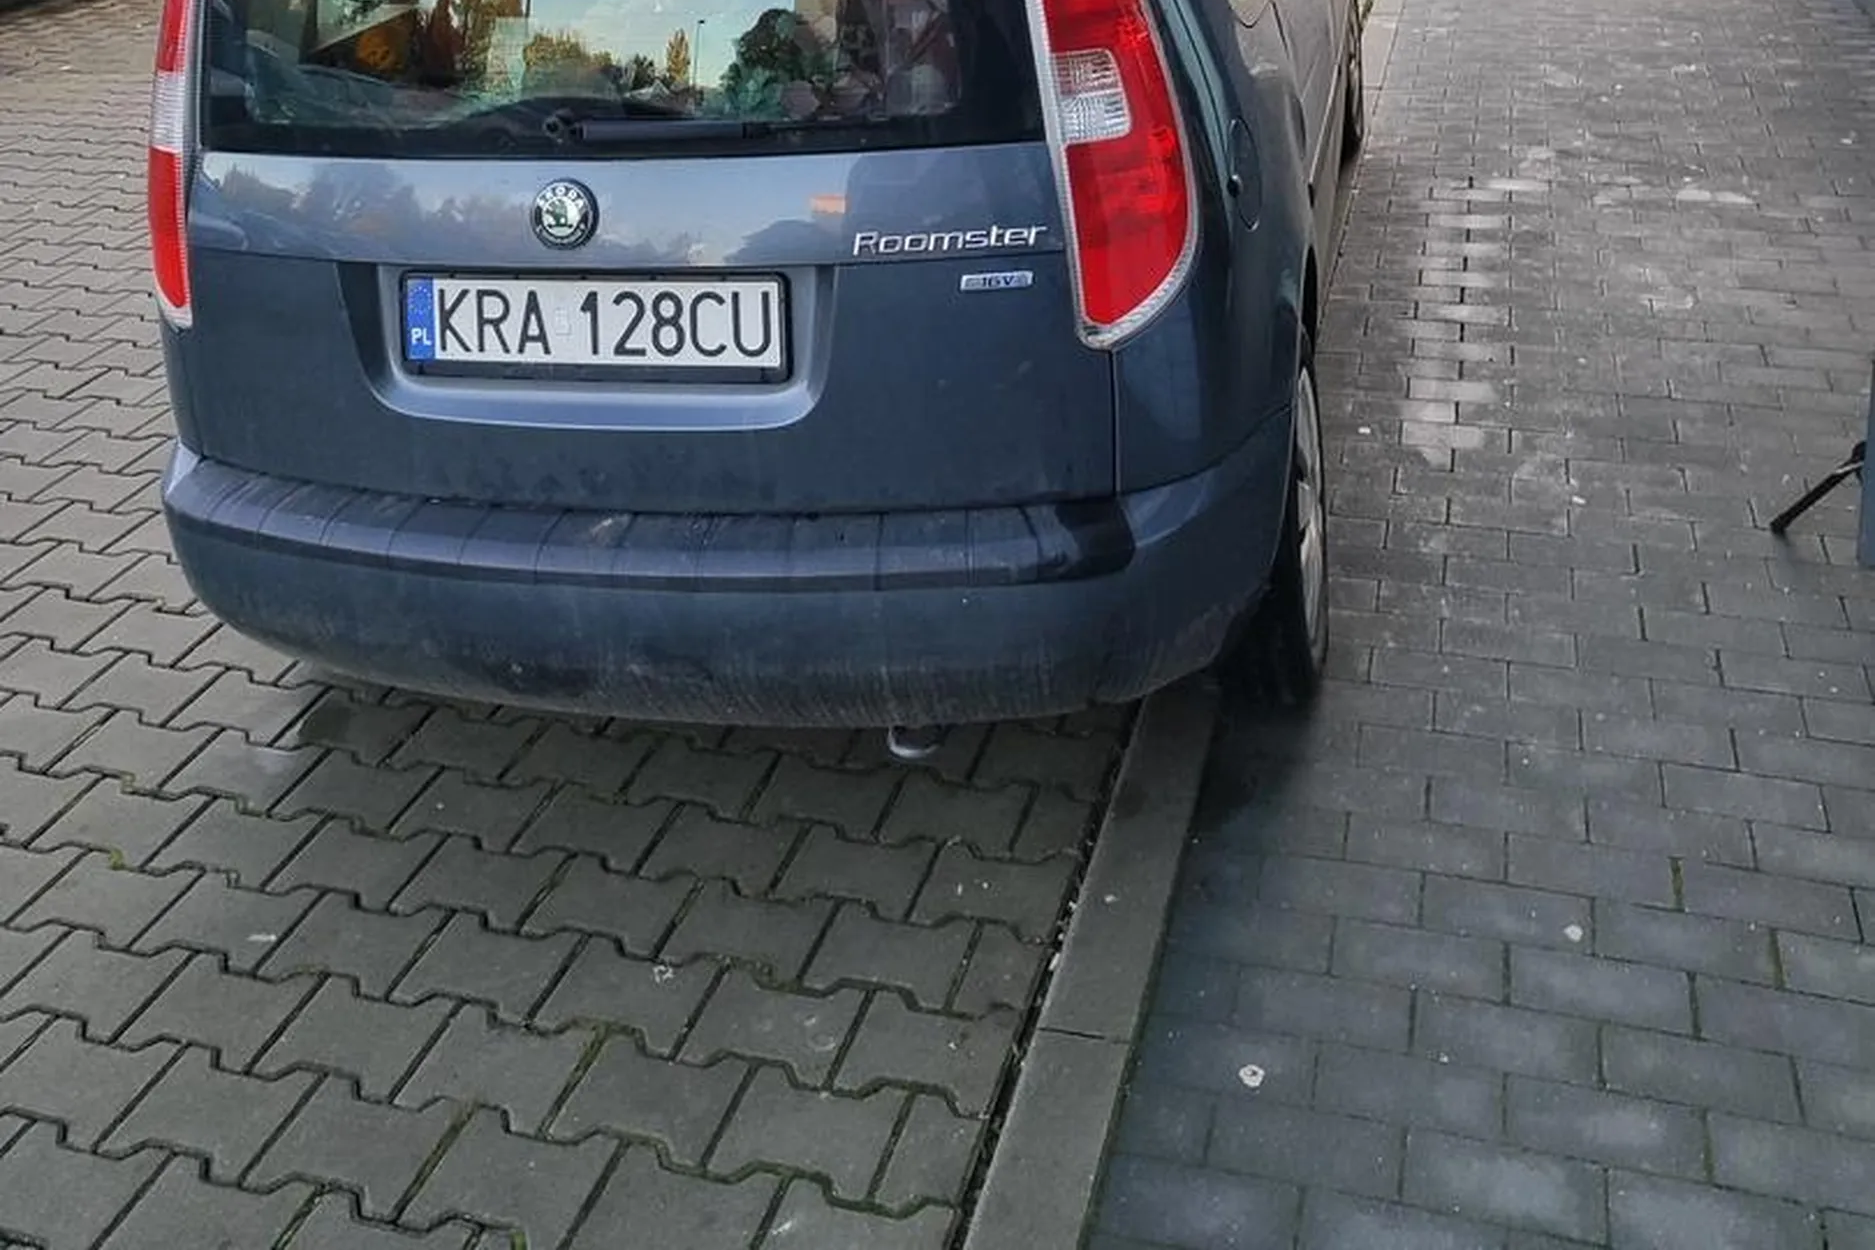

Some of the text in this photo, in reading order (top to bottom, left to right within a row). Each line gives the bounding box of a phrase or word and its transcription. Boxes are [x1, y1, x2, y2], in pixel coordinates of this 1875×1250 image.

[853, 225, 1048, 256] Roomster
[410, 327, 433, 346] PL
[437, 288, 772, 357] KRA 128CU
